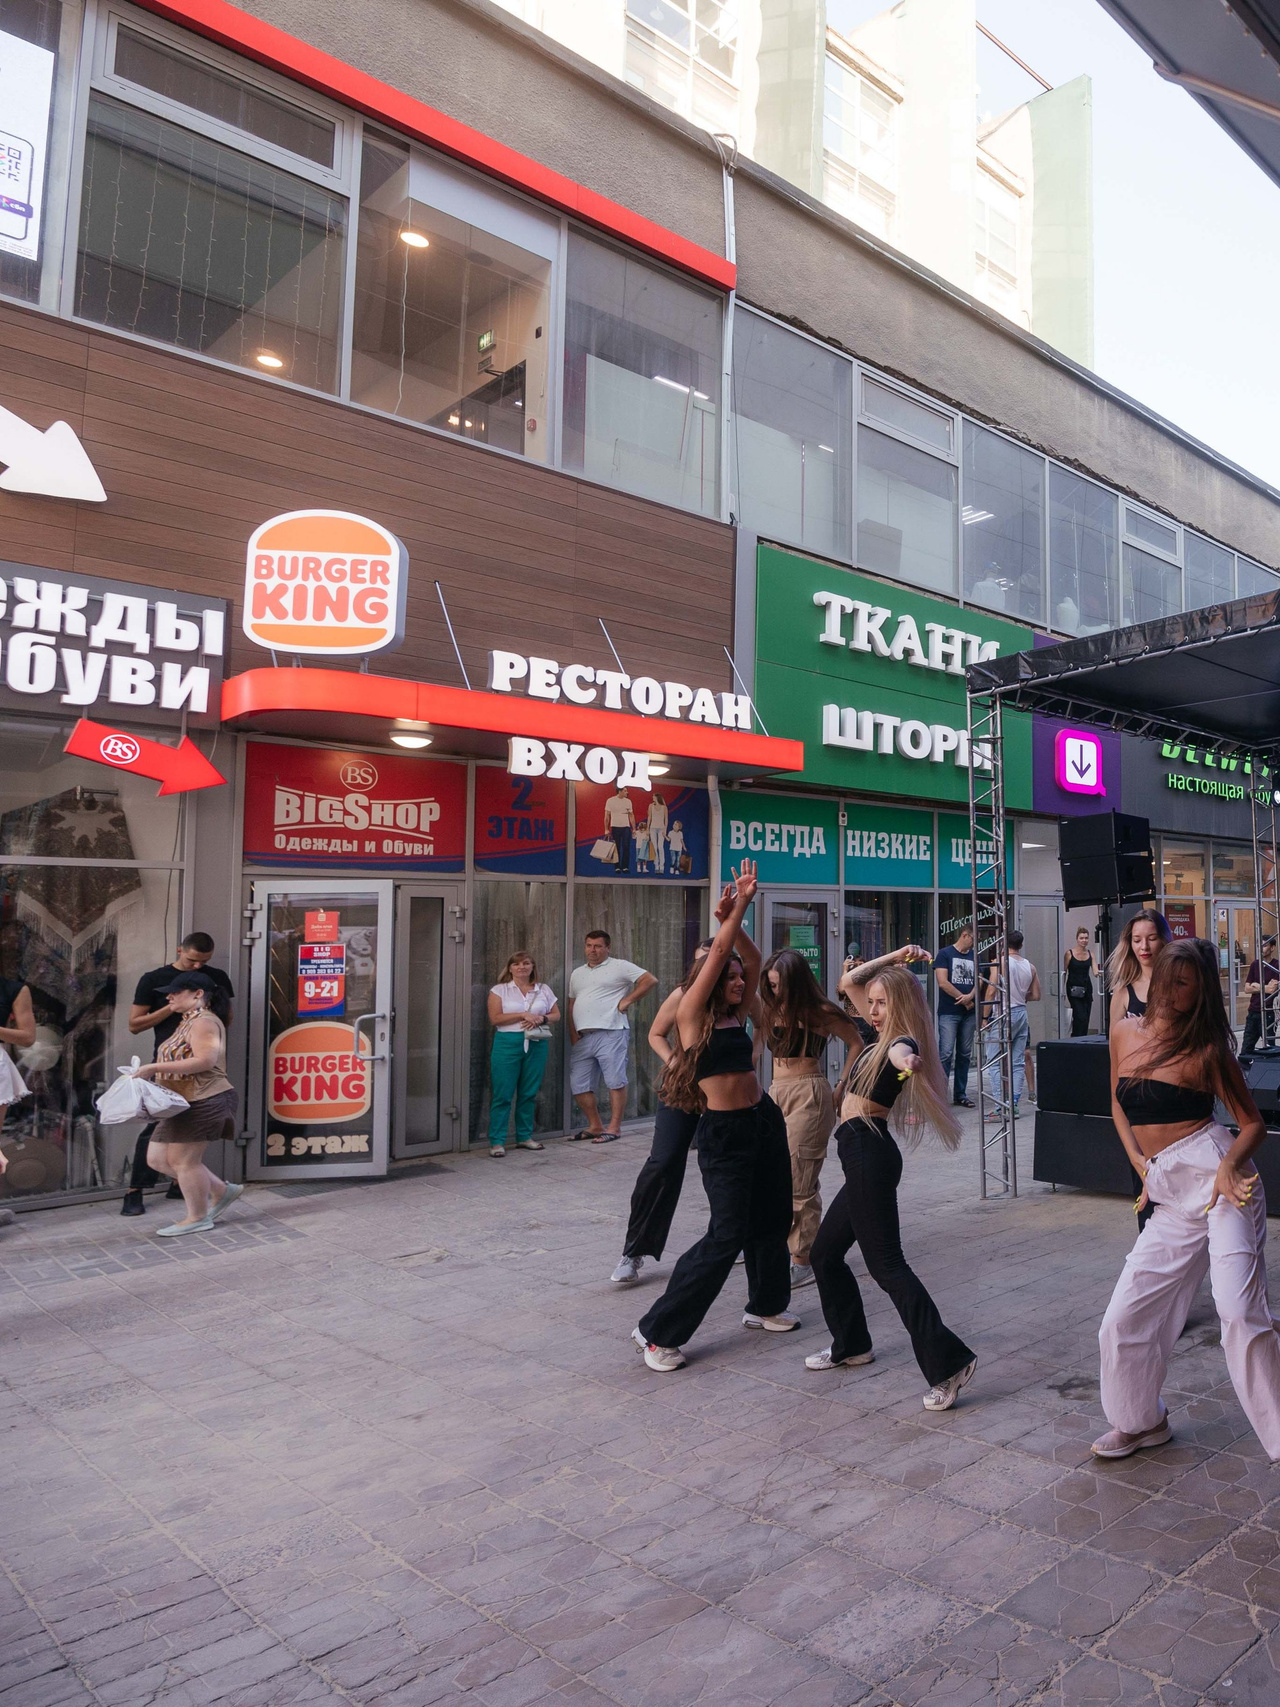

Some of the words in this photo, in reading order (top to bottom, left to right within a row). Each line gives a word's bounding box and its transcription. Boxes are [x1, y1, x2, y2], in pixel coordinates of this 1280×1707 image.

[254, 554, 391, 585] BURGER
[0, 575, 225, 656] жды
[251, 582, 390, 624] KING
[813, 591, 1000, 676] ТКАНИ
[0, 631, 210, 714] буви
[488, 649, 752, 730] РЕСТОРАН
[103, 738, 136, 761] BS
[823, 704, 992, 771] ШТОРЫ
[345, 766, 373, 785] BS
[508, 736, 652, 791] ВХОД
[511, 776, 533, 811] 2
[1168, 772, 1244, 801] настоящая
[487, 815, 554, 841] ЭТАЖ
[729, 820, 826, 858] ВСЕГДА
[846, 829, 931, 861] НИЗКИЕ
[274, 834, 358, 853] Одежды
[364, 841, 376, 853] и
[382, 839, 434, 856] Обуви
[304, 981, 339, 998] 9-21
[274, 1054, 366, 1075] BURGER
[273, 1073, 366, 1103] KING
[267, 1134, 285, 1157] 2
[291, 1134, 370, 1156] этаж
